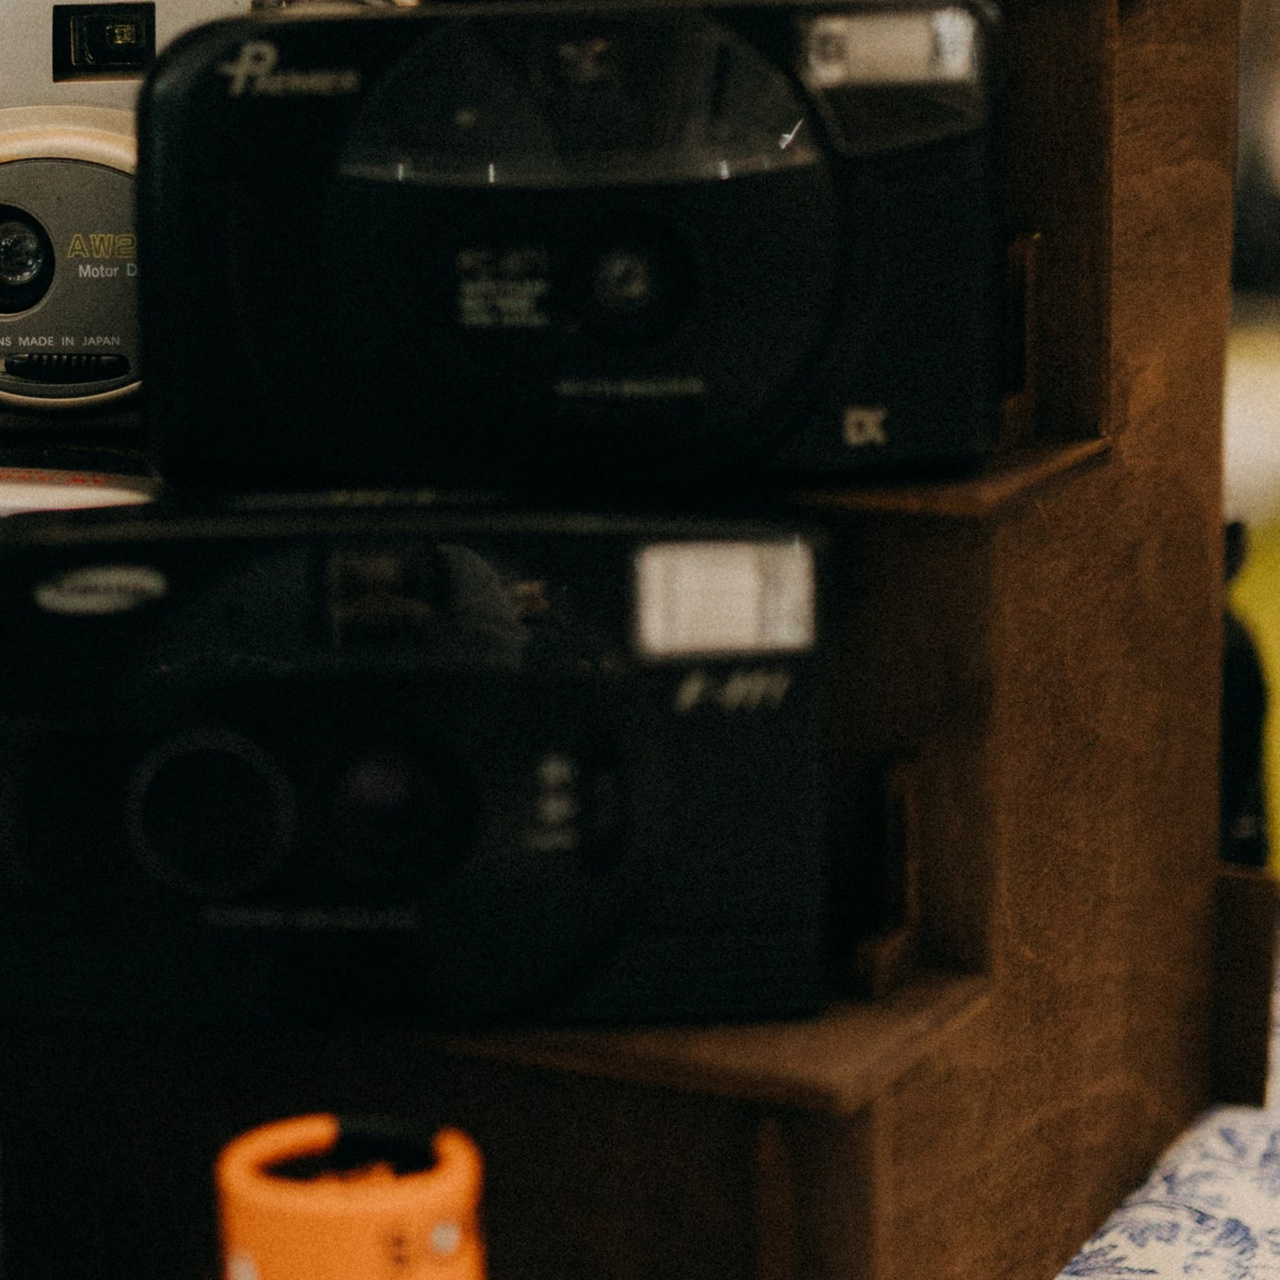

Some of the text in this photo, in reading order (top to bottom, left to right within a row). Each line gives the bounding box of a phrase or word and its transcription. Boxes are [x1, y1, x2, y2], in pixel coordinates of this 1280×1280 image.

[78, 264, 119, 278] Motor
[19, 336, 54, 347] MADE
[61, 336, 74, 346] IN
[82, 335, 121, 346] JAPAN
